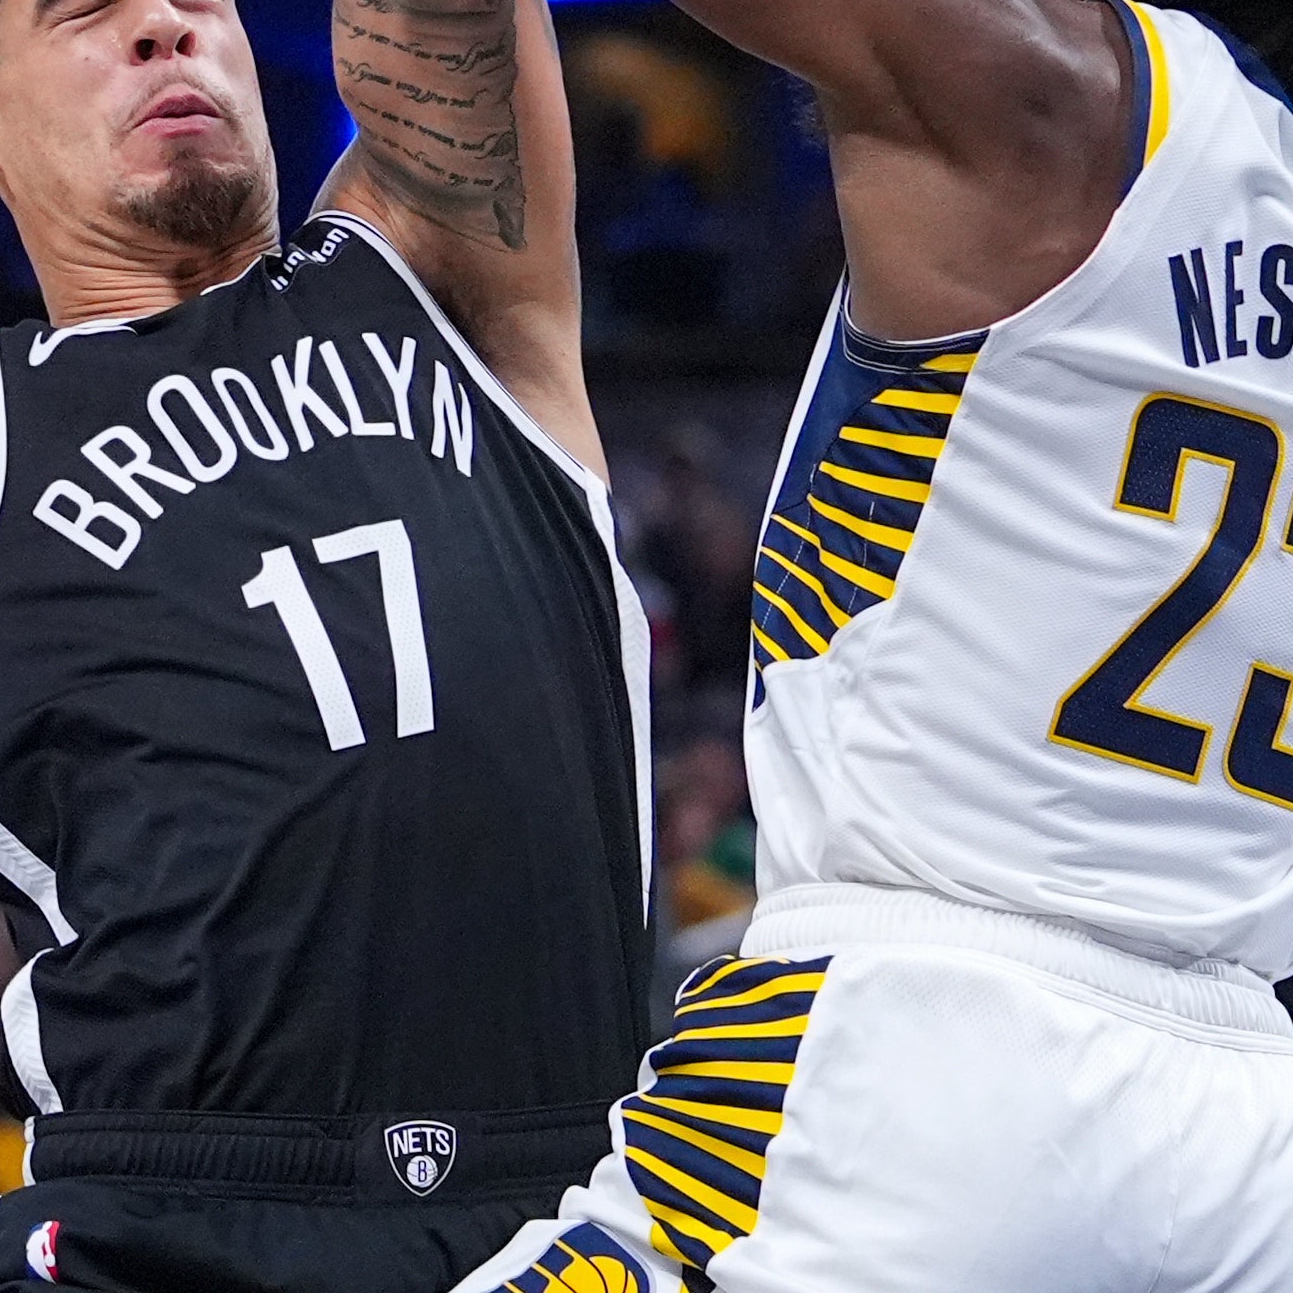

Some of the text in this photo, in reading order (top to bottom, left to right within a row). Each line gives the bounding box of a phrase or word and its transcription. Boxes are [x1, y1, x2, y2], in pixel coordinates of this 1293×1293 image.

[32, 331, 474, 570] BROOKLYN
[240, 518, 435, 752] 17
[392, 1127, 451, 1158] NETS
[417, 1160, 428, 1183] B
